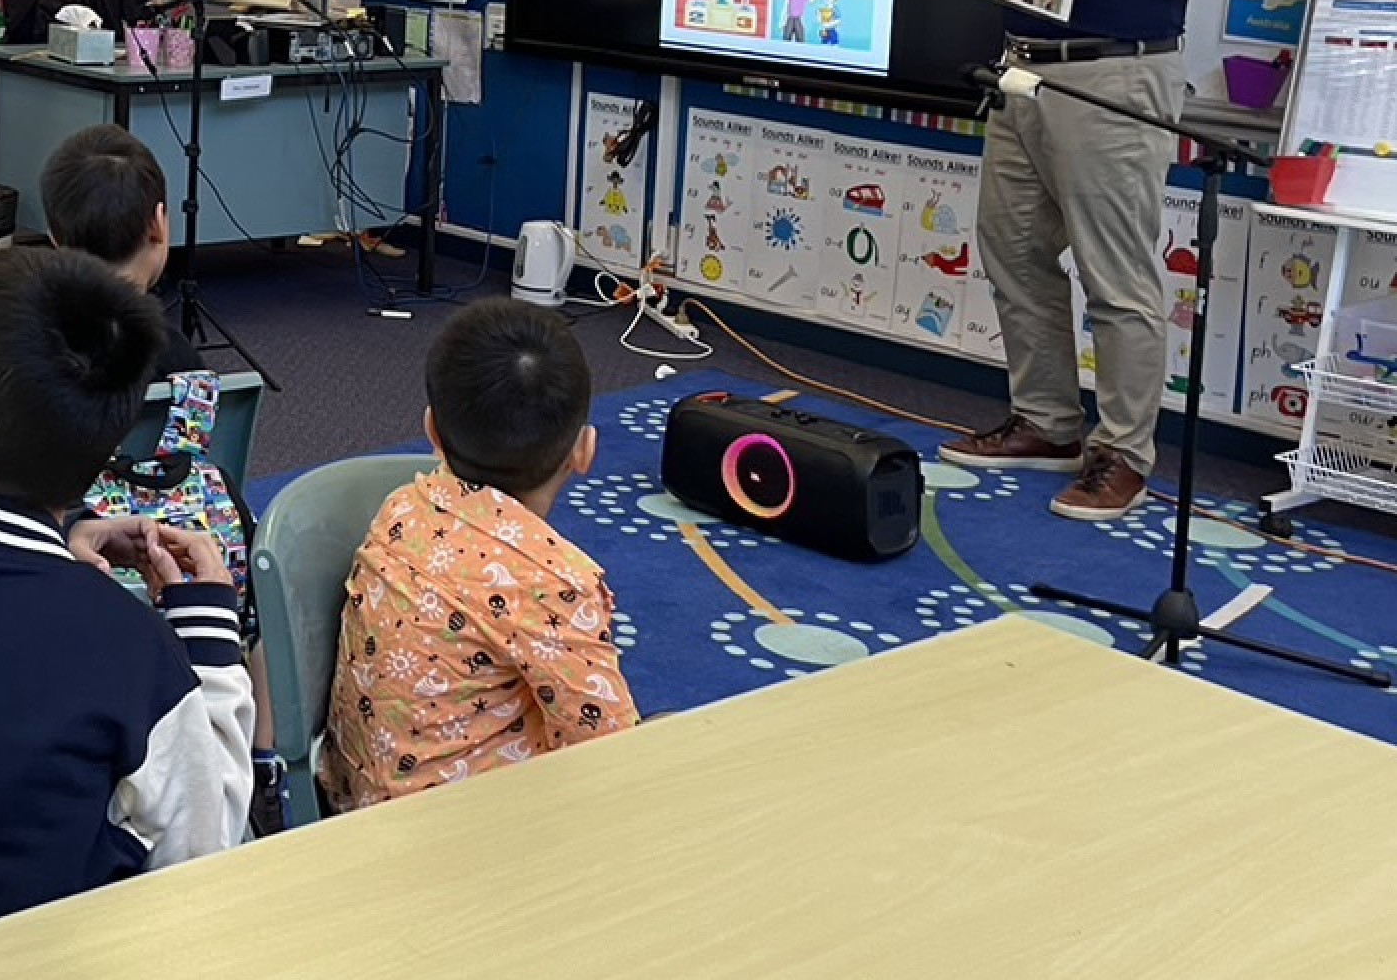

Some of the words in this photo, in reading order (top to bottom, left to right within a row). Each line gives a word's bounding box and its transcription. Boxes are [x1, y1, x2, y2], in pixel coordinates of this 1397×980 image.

[692, 115, 724, 130] Sounds
[762, 127, 795, 145] Sounds
[796, 133, 825, 149] Alike!
[834, 141, 869, 160] Sounds
[871, 148, 902, 166] Alike!
[906, 152, 944, 171] Sounds
[946, 160, 979, 177] Alike!
[1250, 340, 1271, 365] ph
[1248, 384, 1269, 408] ph
